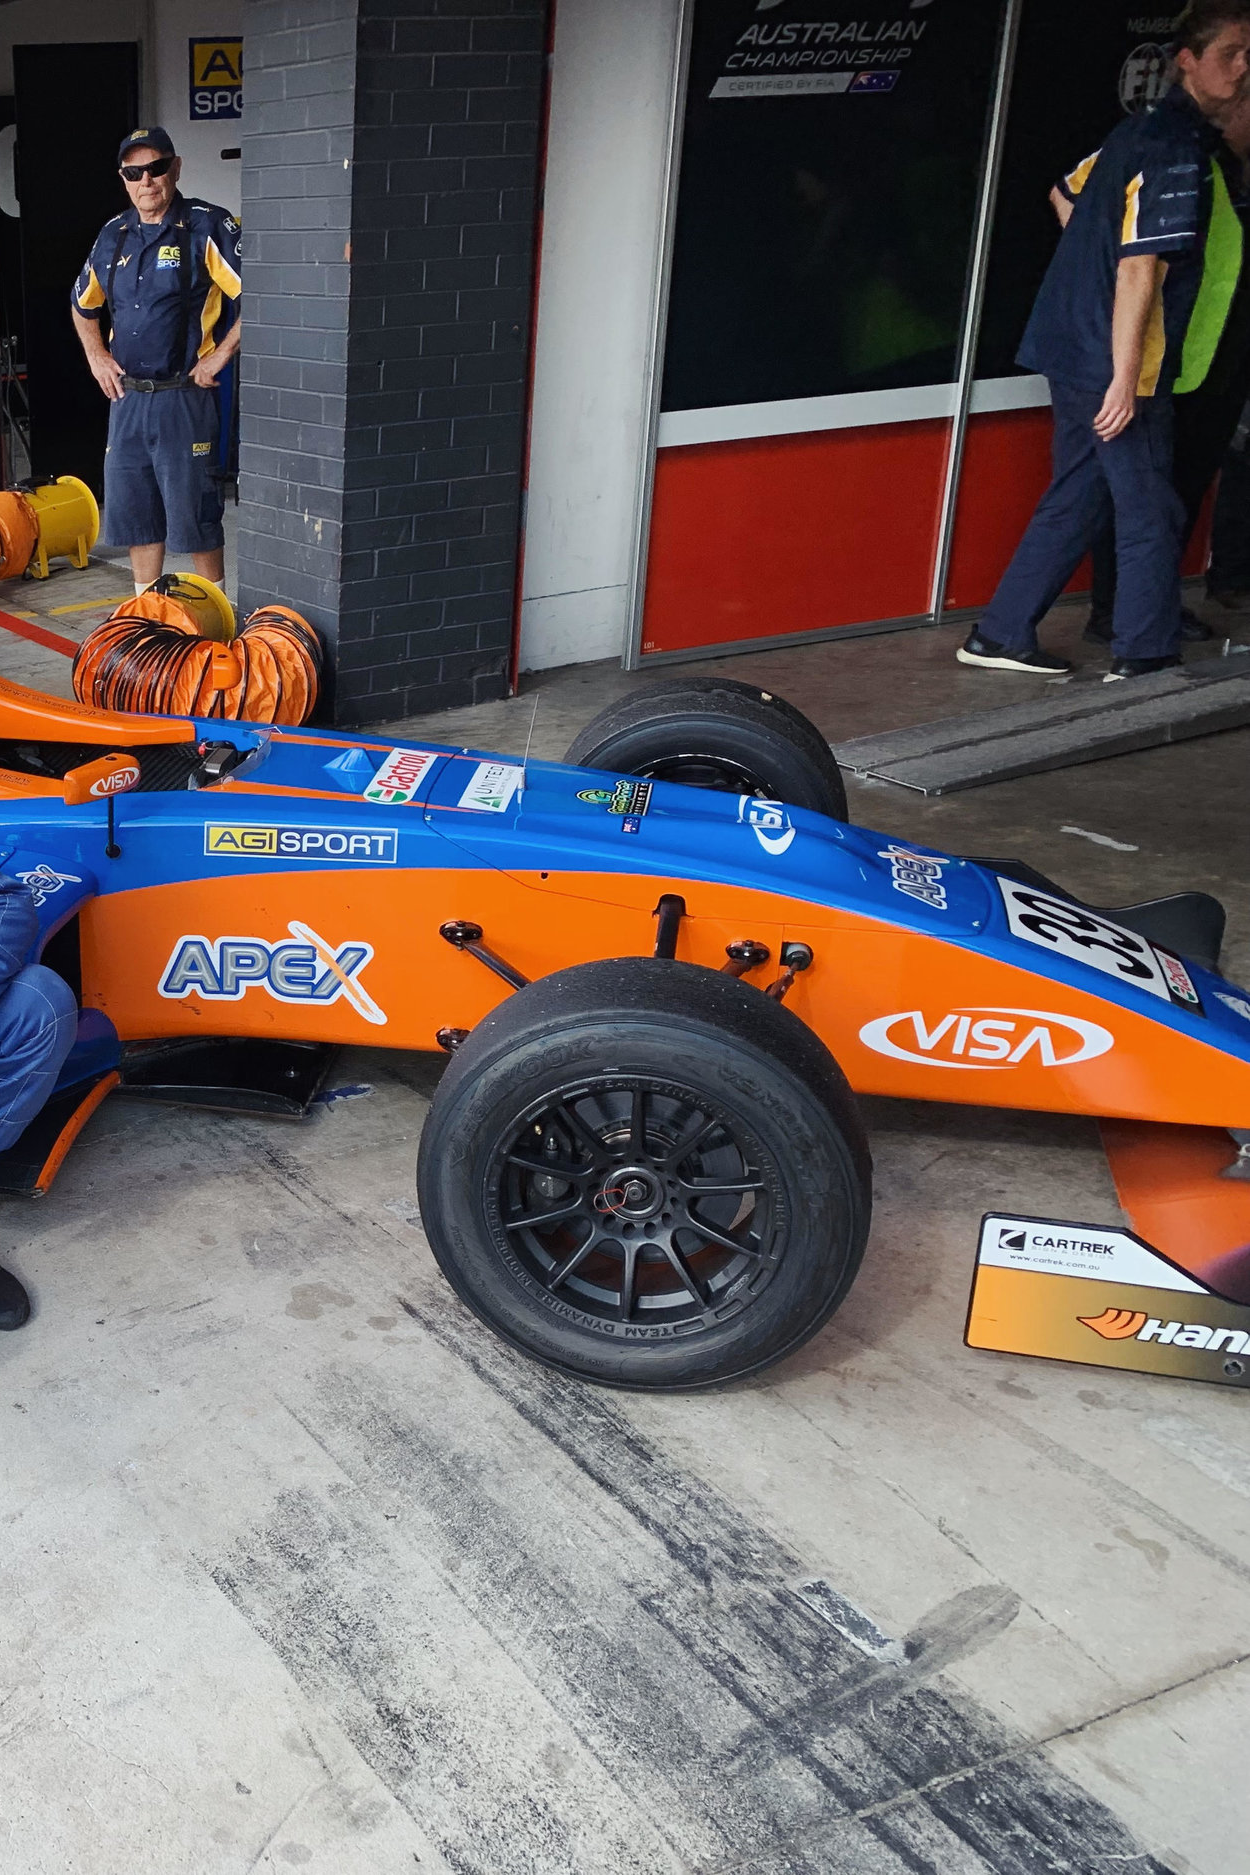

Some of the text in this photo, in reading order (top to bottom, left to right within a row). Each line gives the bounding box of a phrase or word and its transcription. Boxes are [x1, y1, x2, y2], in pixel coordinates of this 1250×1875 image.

[736, 20, 927, 45] AUSTRALIAN
[725, 48, 911, 68] CHAMPIONSHIP
[729, 79, 836, 91] CERTIFIED BY FIA
[102, 771, 135, 790] VISA
[377, 751, 430, 791] Castrol
[474, 765, 505, 795] UNITED
[214, 831, 392, 856] AGI SPORT
[877, 844, 951, 911] APEX
[1012, 891, 1154, 980] 39
[157, 920, 388, 1025] APEX
[911, 1010, 1058, 1067] VISA
[1032, 1235, 1117, 1257] CARTREK
[1009, 1254, 1101, 1271] www.cartrek.com.au
[624, 1326, 675, 1338] TEAM
